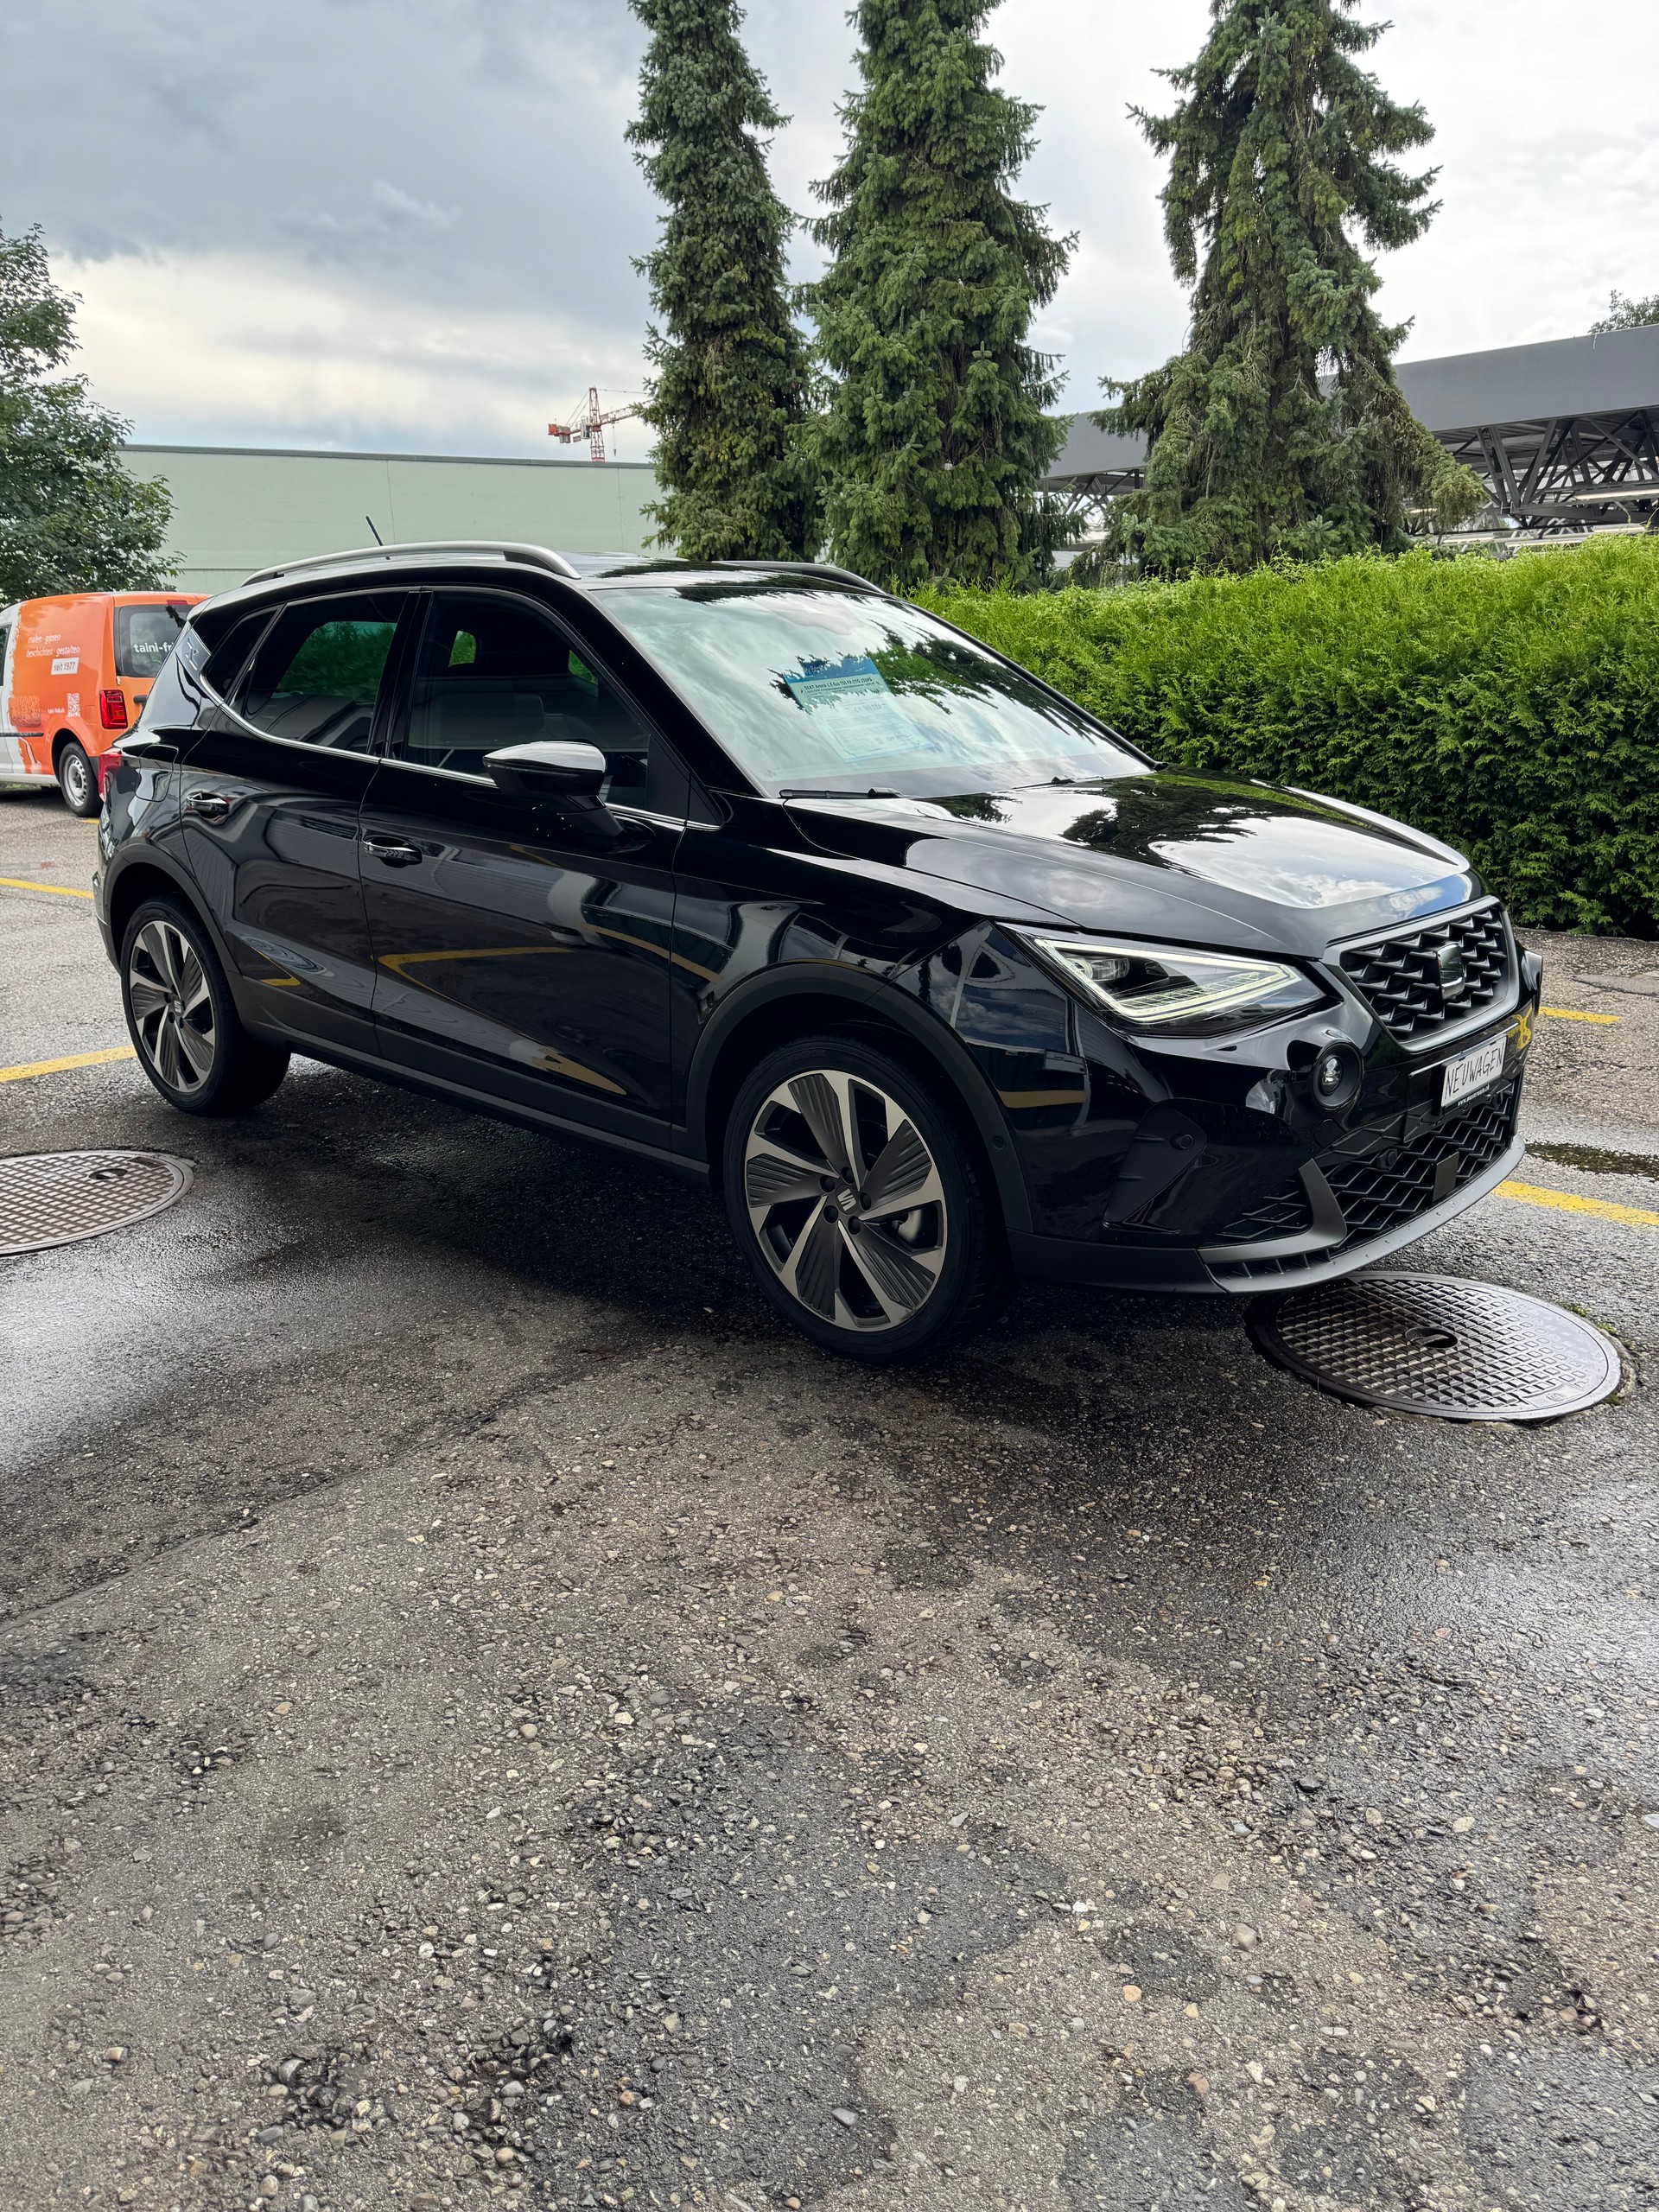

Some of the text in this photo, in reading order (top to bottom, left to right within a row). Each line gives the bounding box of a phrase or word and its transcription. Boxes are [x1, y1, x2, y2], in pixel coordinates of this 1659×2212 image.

[54, 661, 76, 671] seit 1977
[1445, 1042, 1504, 1100] NEUWAGEN
